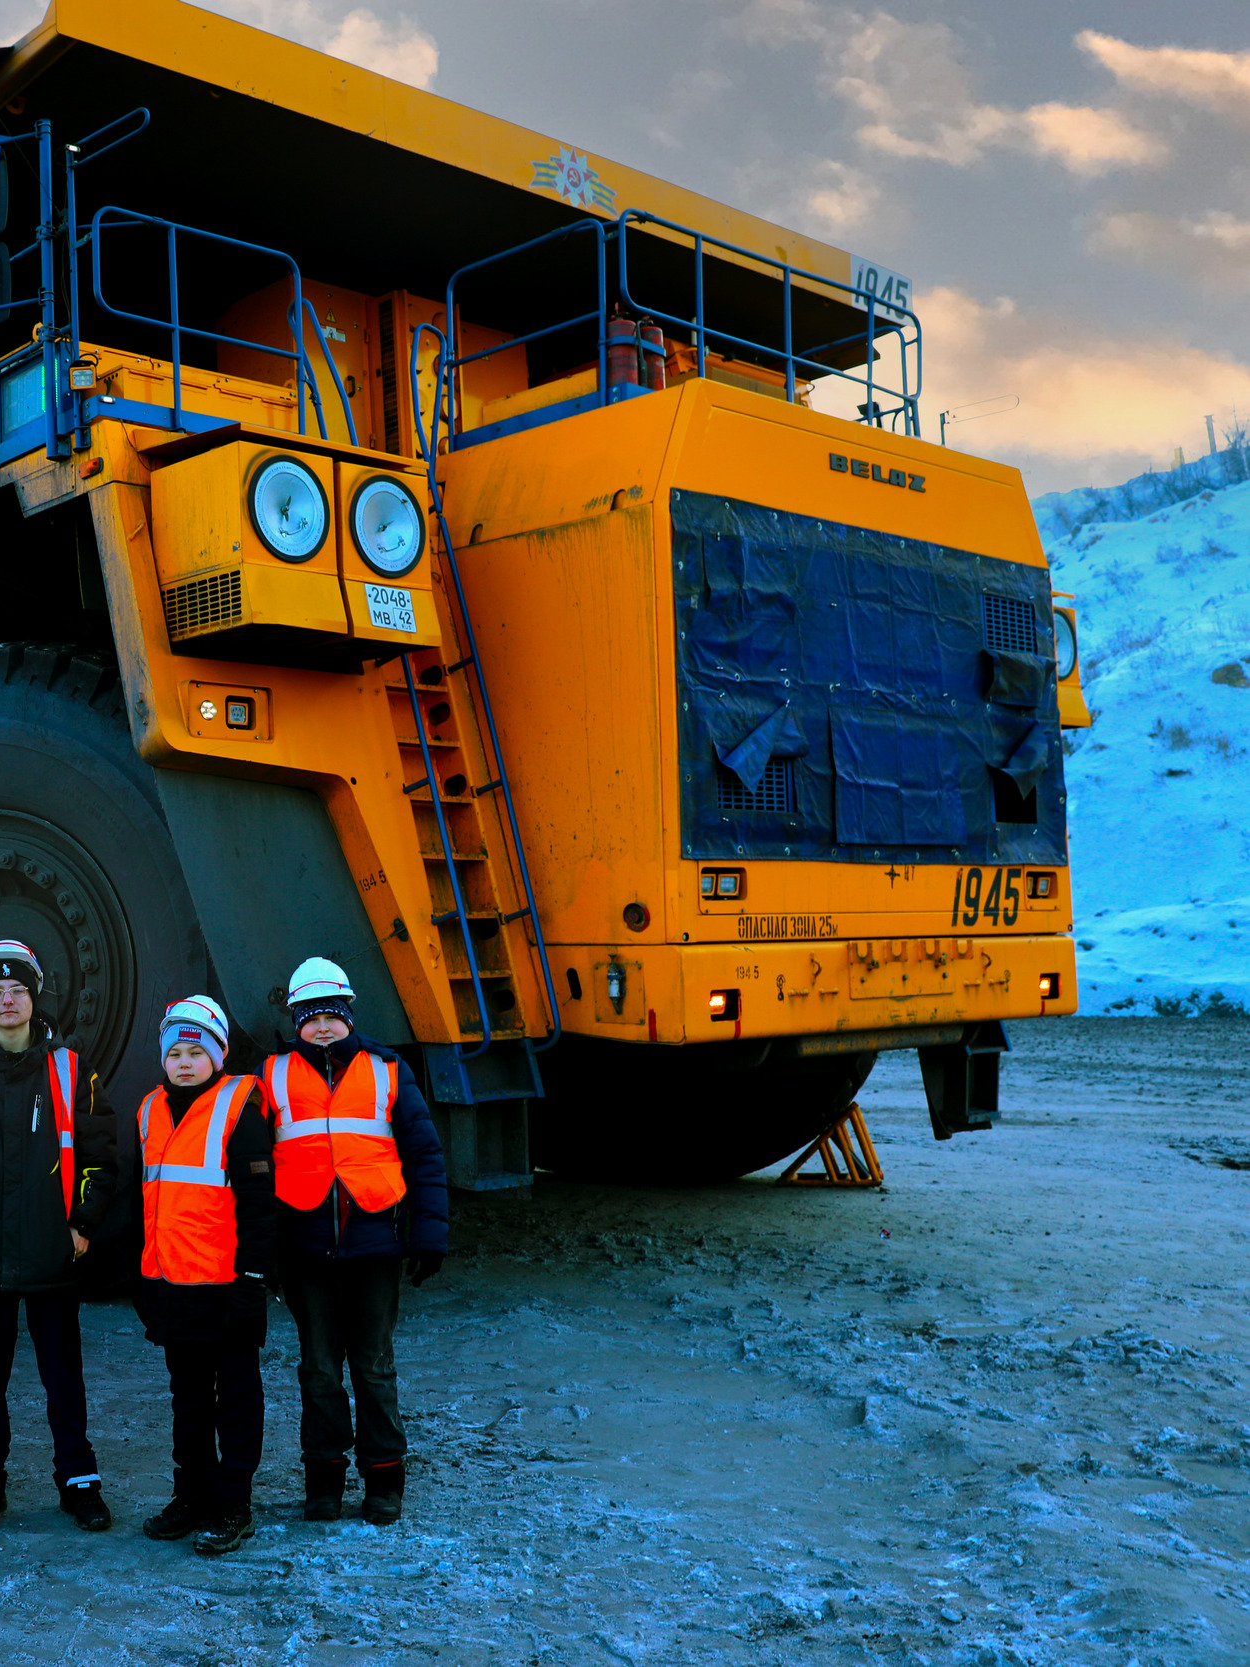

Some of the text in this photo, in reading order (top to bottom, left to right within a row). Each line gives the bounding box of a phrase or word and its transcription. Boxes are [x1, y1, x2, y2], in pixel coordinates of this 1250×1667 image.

[854, 264, 909, 319] 1945
[829, 452, 926, 493] BELAZ
[371, 586, 407, 608] 2048
[398, 611, 412, 625] 42
[951, 867, 1021, 927] 1945
[738, 916, 788, 939] ОПАСНАЯ
[790, 915, 817, 938] ЗОНА
